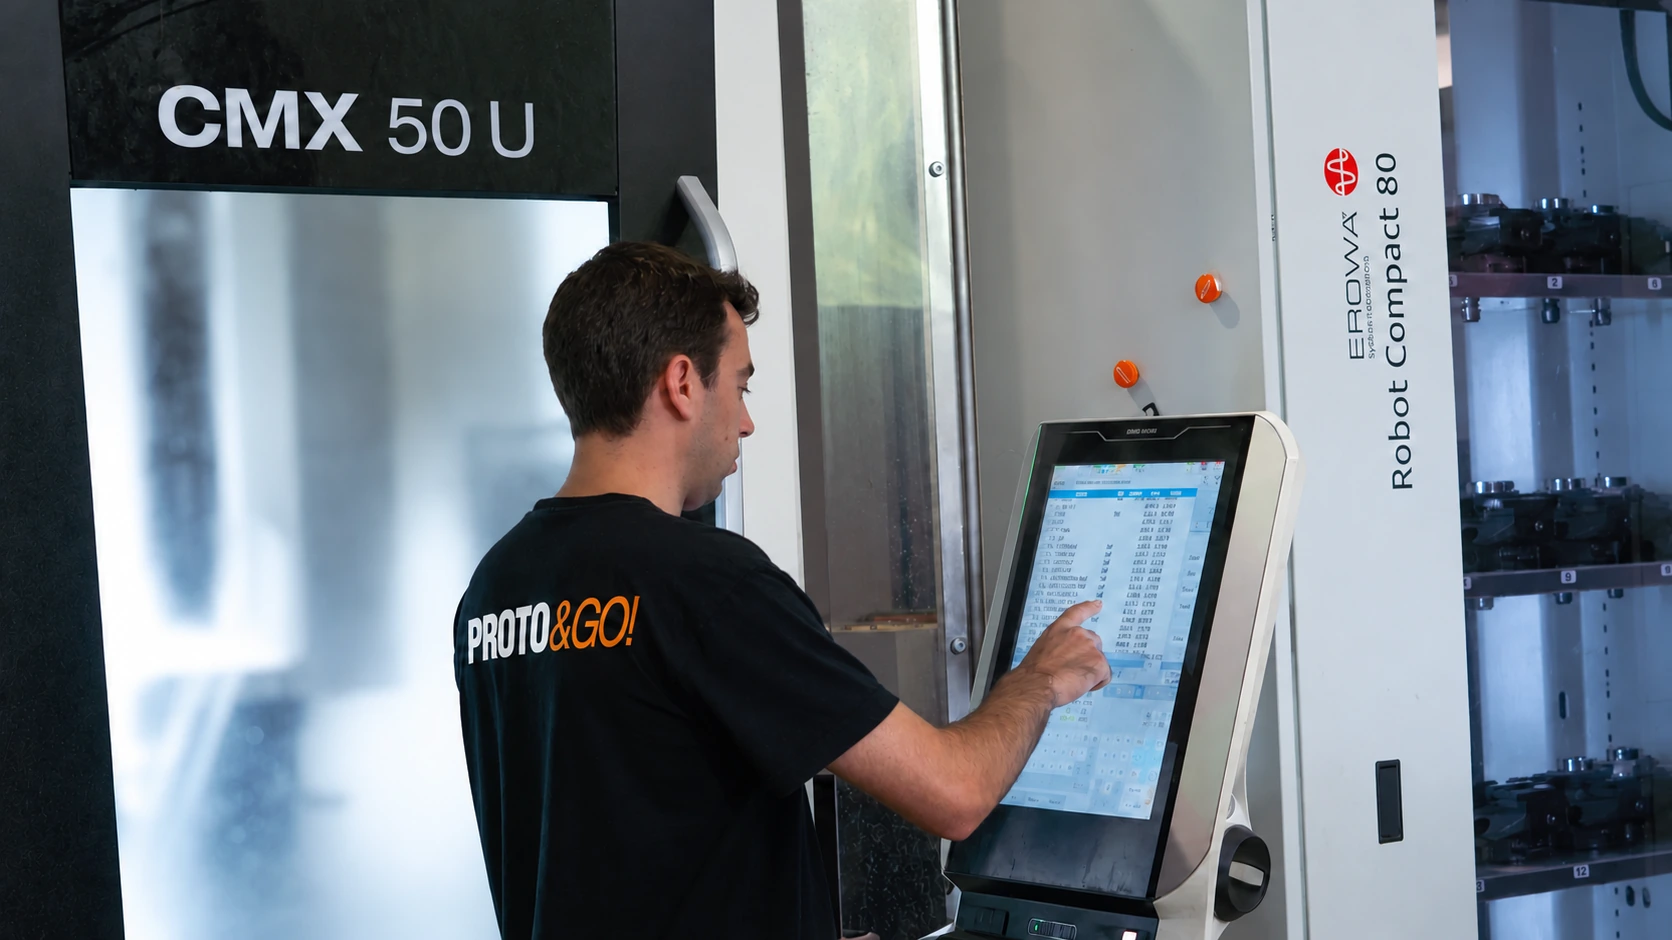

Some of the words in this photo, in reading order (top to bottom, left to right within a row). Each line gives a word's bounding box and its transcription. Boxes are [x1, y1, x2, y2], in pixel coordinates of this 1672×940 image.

[158, 84, 363, 152] CMX
[388, 97, 471, 156] 50
[489, 100, 534, 158] U
[1375, 153, 1398, 195] 80
[1342, 211, 1365, 359] EROWA
[1379, 208, 1407, 367] Compact
[1388, 380, 1413, 489] Robot
[467, 595, 640, 665] PROTO&GO!
